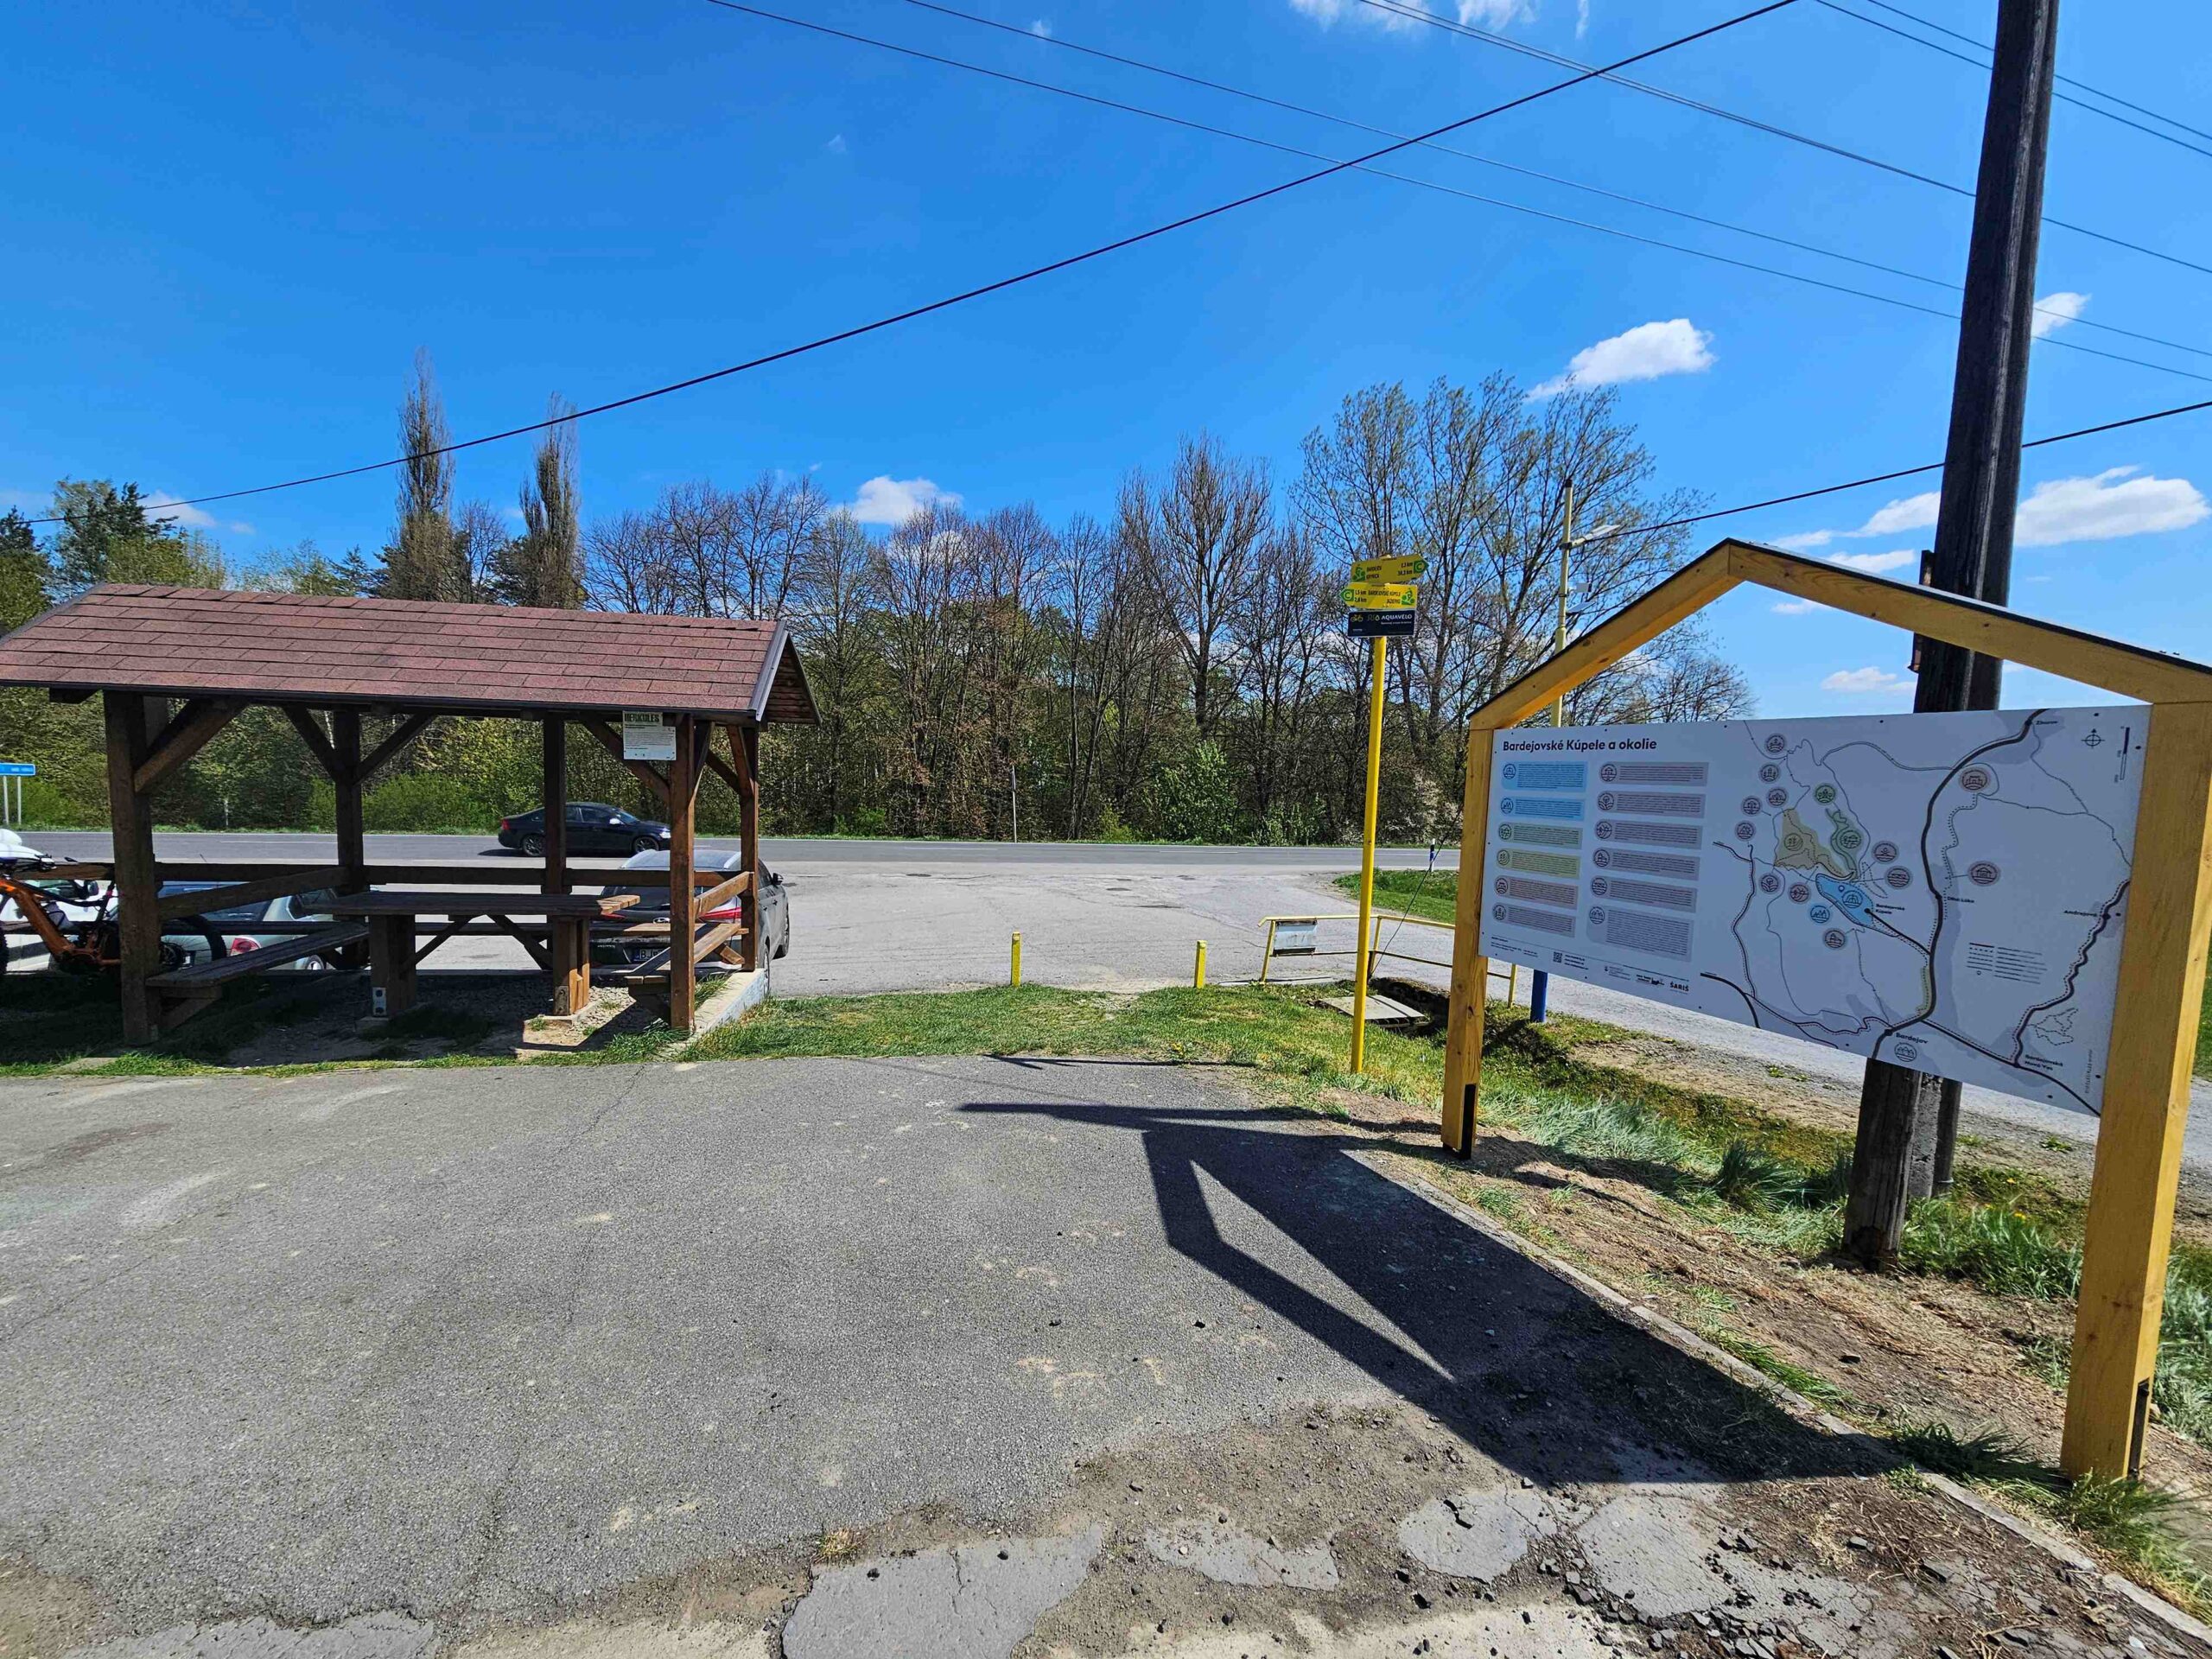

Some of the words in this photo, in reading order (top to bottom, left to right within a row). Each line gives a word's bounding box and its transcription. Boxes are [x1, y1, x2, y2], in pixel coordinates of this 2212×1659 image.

[1503, 740, 1564, 753] Bardejovské
[1566, 739, 1605, 753] Kúpele
[1608, 741, 1616, 750] a
[1618, 738, 1657, 750] okolie
[1669, 981, 1689, 992] ŠARIŠ
[1896, 1032, 1929, 1045] Bardejov
